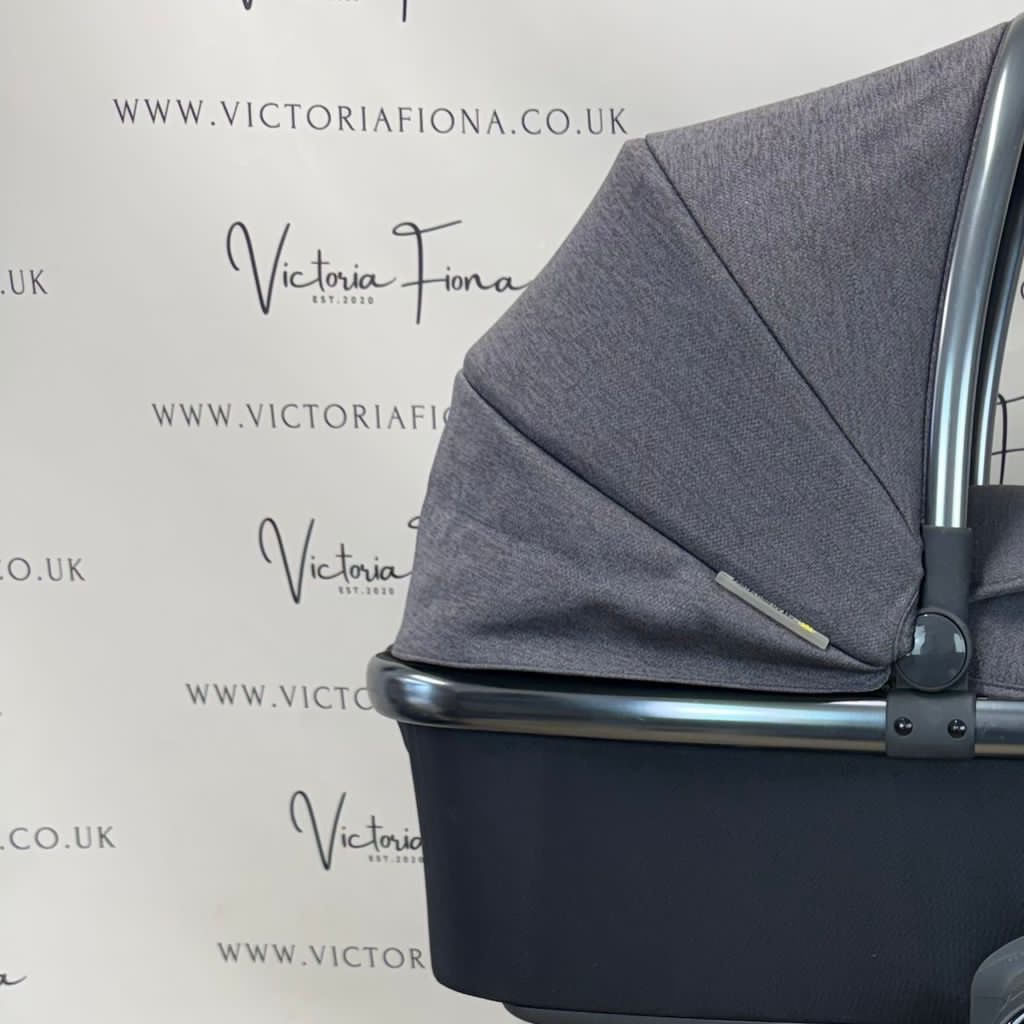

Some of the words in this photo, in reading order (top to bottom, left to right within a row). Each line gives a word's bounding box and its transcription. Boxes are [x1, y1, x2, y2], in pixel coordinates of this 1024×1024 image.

[113, 98, 628, 136] WWW.VICTORIAFIONA.CO.UK
[226, 220, 396, 316] Victoria
[392, 220, 534, 325] Fiona
[312, 296, 374, 304] EST.2020
[152, 403, 447, 431] WWW.VICTORIAFI
[259, 517, 411, 604] Victoria
[338, 587, 395, 596] EST.2020
[289, 790, 423, 871] Victoria
